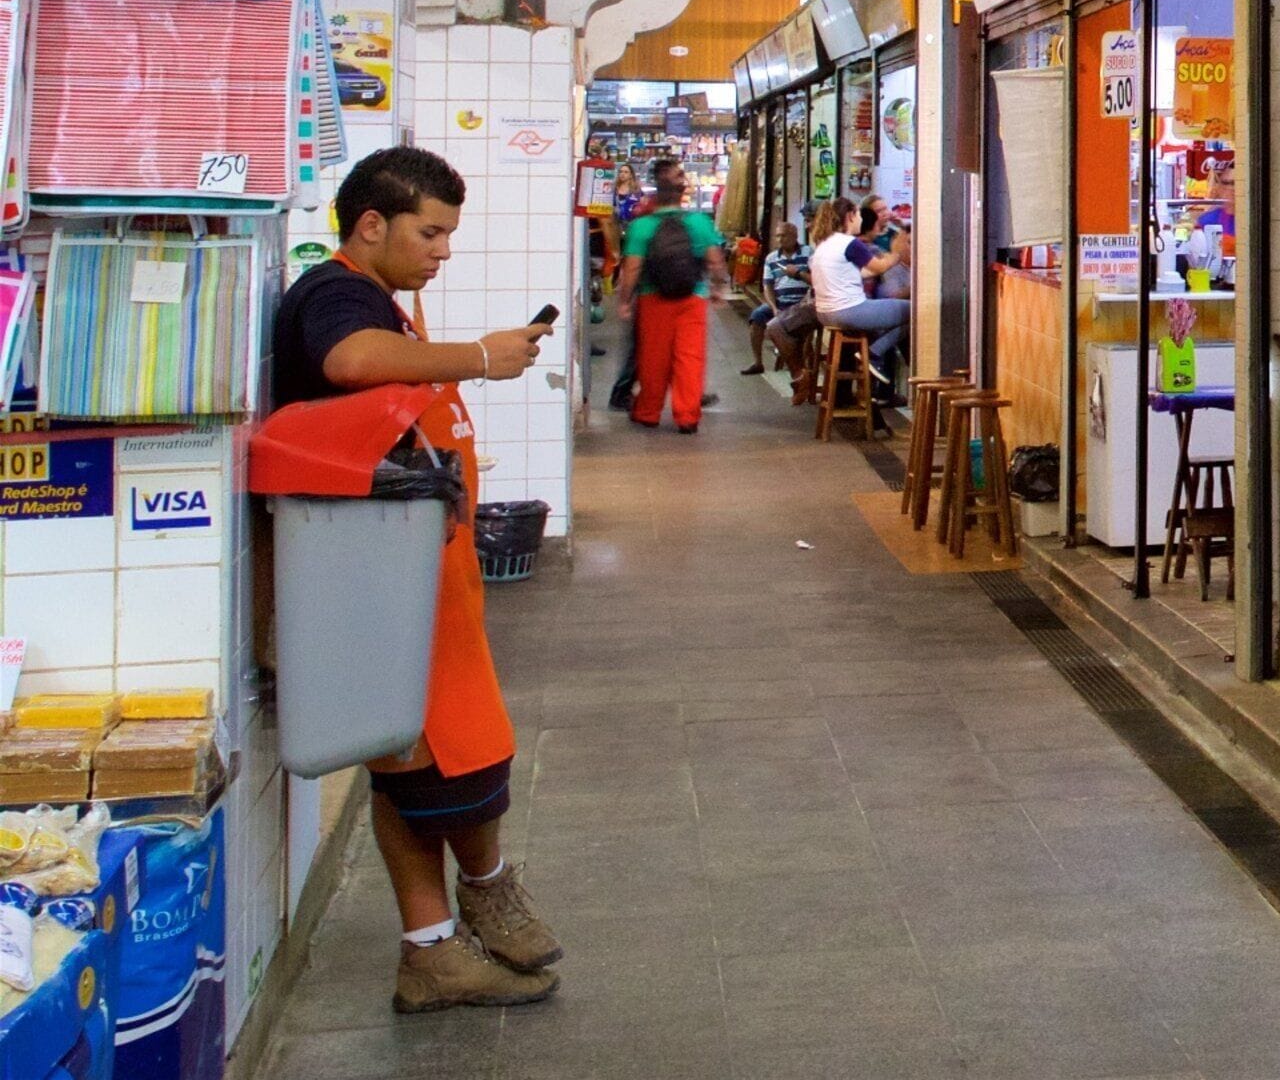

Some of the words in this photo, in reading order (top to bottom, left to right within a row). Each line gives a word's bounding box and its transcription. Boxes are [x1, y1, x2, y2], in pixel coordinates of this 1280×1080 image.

[1082, 236, 1099, 247] POR
[123, 436, 215, 452] International
[3, 484, 76, 502] RedeShop
[78, 483, 88, 497] é
[21, 499, 83, 516] Maestro
[142, 490, 207, 513] VISA
